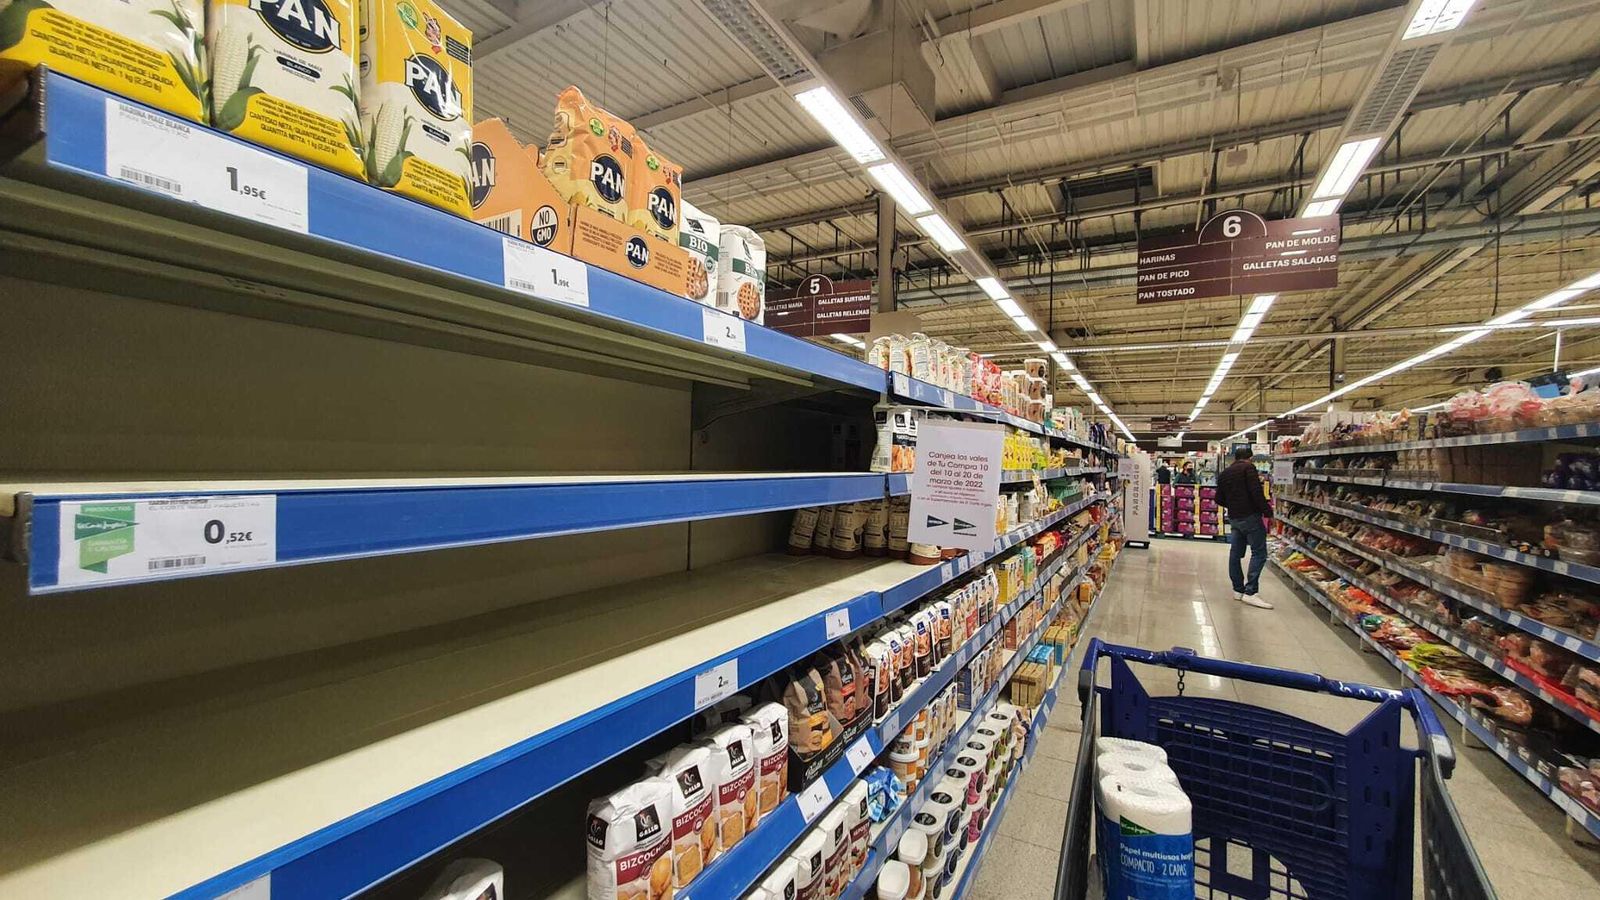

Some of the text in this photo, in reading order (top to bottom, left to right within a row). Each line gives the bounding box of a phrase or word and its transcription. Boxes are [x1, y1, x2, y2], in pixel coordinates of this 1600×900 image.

[249, 0, 340, 49] AN
[472, 158, 495, 187] AN
[590, 161, 624, 198] PAN
[226, 166, 266, 200] 1,95€
[648, 192, 677, 222] PAN
[539, 210, 550, 226] NO
[536, 227, 552, 242] GMO
[1222, 216, 1242, 238] 6
[688, 236, 708, 253] BIO
[1266, 235, 1336, 250] PAN DE MOLDE
[626, 242, 650, 263] PAN
[1140, 254, 1176, 264] HARINAS
[1243, 254, 1336, 271] GALLETAS SALADAS
[1139, 270, 1190, 282] PAN DE PICO
[810, 278, 820, 294] 5
[1138, 288, 1195, 300] PAN TOSTADO
[844, 294, 870, 303] SURTIDAS
[842, 308, 870, 317] RELLENAS
[929, 452, 956, 462] Canjea
[947, 462, 978, 471] Compra
[965, 480, 983, 488] 2022
[204, 520, 253, 544] 0,52€
[684, 782, 700, 795] GALLO
[639, 825, 658, 837] GALLO
[1120, 843, 1140, 856] Papel
[1142, 851, 1180, 860] multiusos
[1120, 854, 1186, 876] COMPACTO 2 CAPAS
